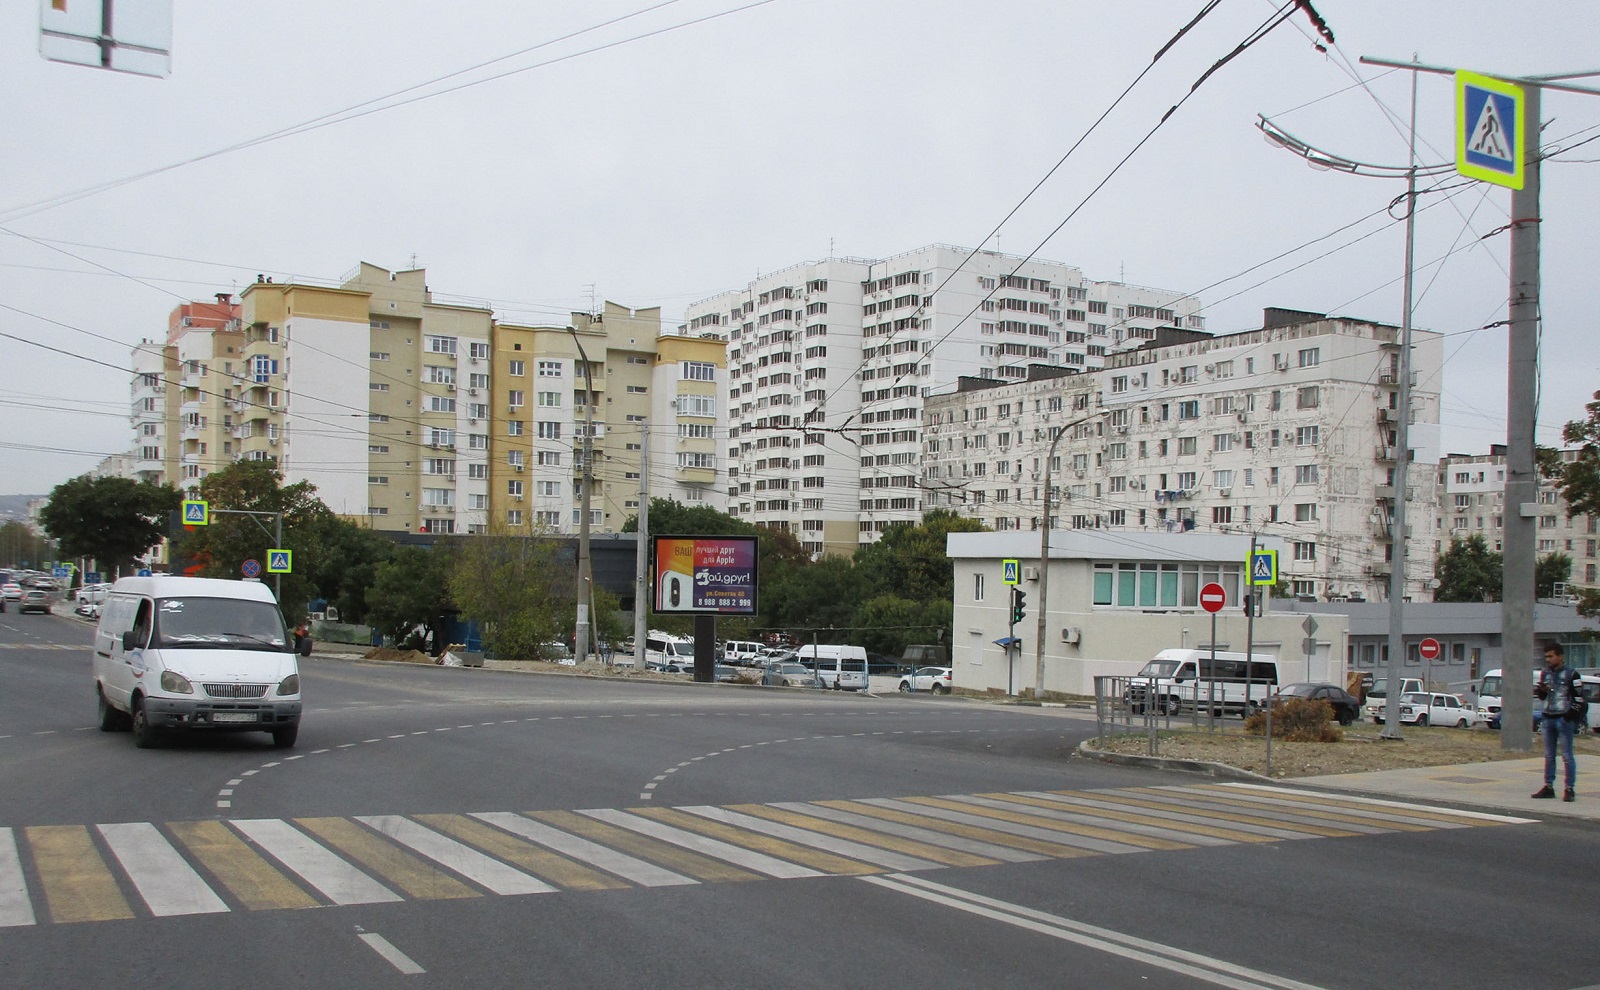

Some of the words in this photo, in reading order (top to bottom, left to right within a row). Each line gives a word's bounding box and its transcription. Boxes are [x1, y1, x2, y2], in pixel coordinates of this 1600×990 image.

[674, 547, 692, 556] ВАШ
[696, 546, 718, 555] лучший
[720, 547, 735, 555] друг
[716, 556, 735, 564] Apple
[719, 598, 730, 606] 888
